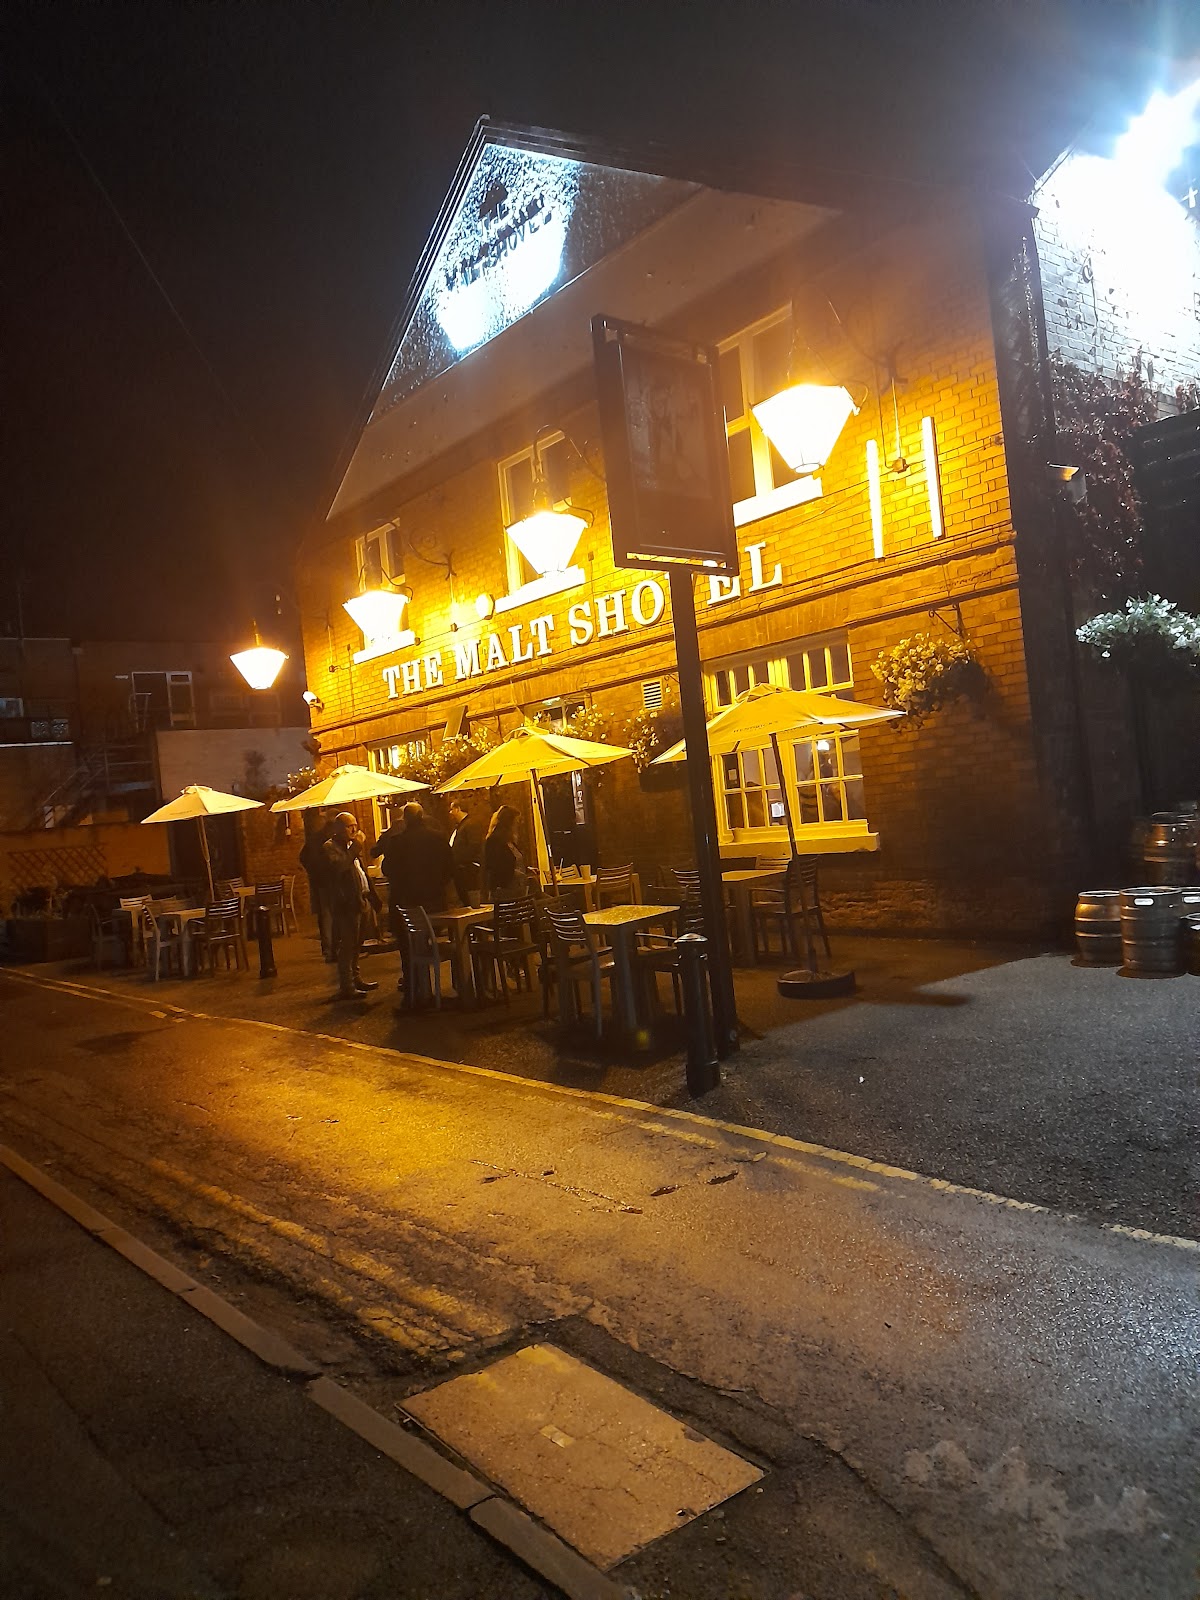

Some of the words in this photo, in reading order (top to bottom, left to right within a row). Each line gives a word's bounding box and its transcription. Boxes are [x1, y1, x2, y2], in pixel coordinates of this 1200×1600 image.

[382, 653, 443, 700] THE
[454, 615, 555, 682] MALT
[568, 541, 783, 647] SHOEL
